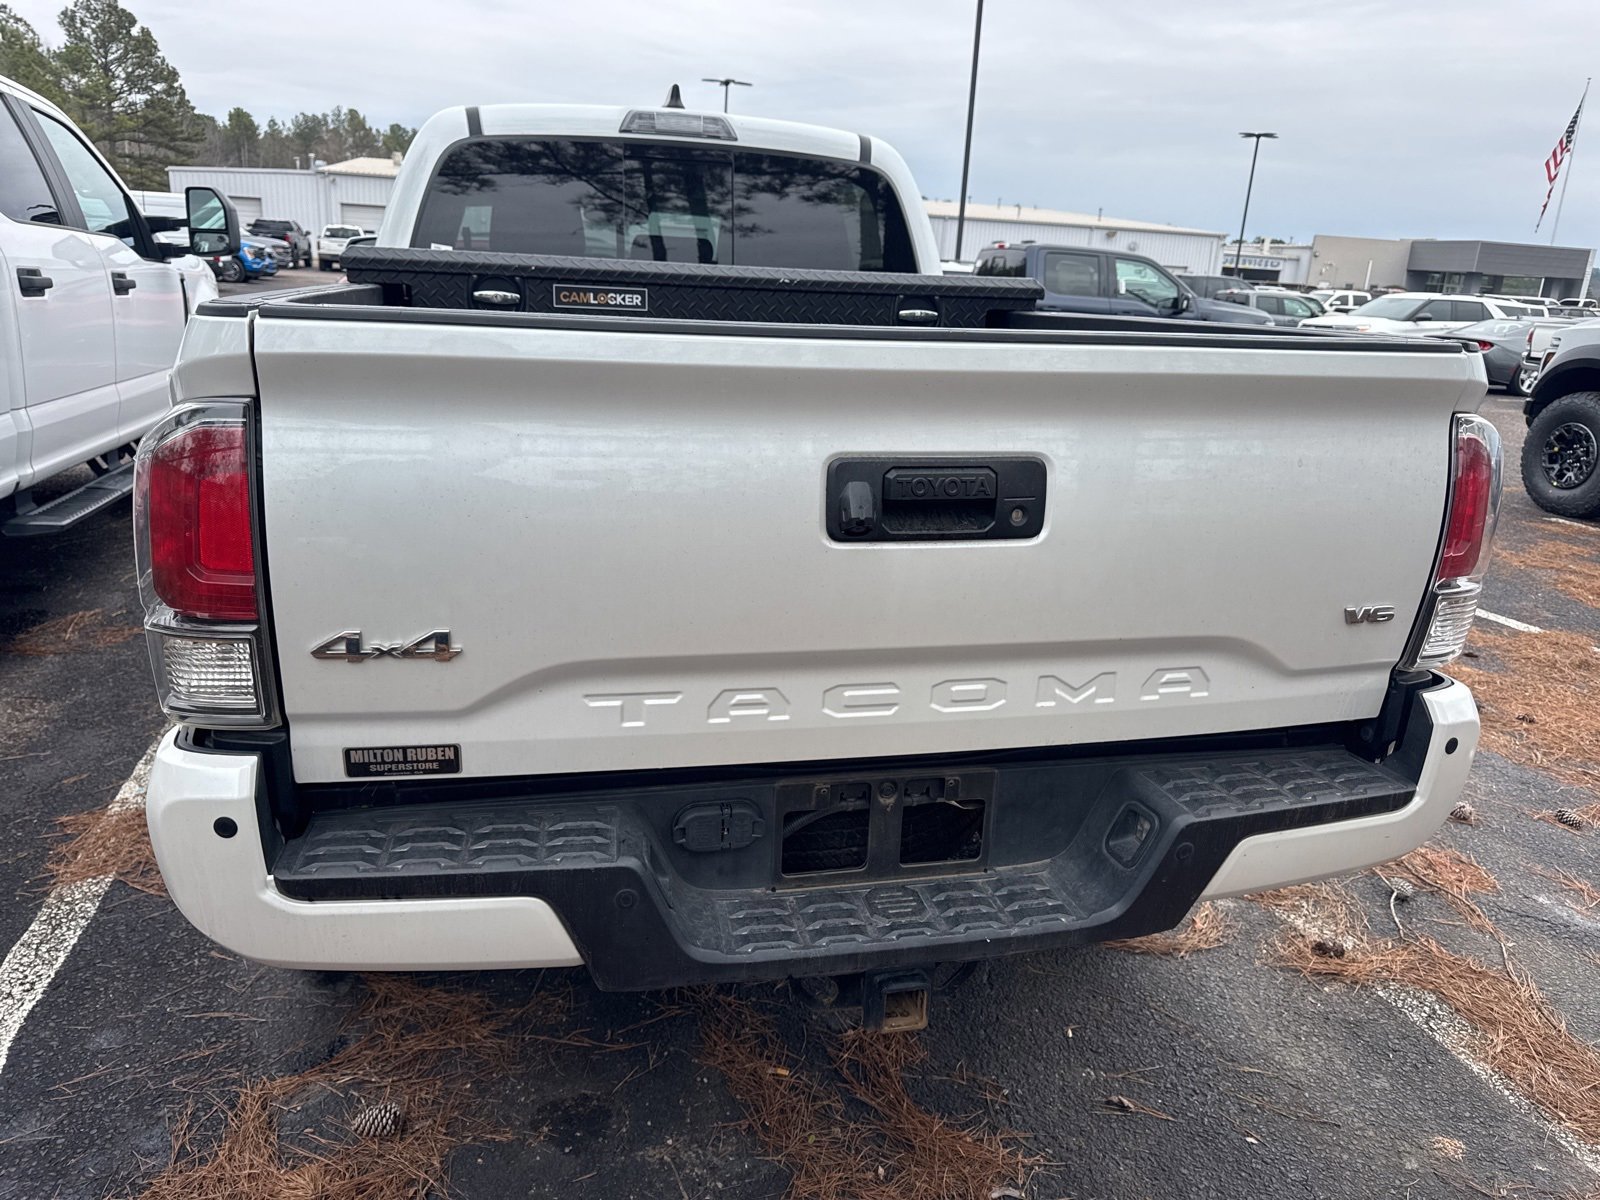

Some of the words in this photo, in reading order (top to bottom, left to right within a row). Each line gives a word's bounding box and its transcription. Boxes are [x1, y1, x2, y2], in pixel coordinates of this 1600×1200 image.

[560, 291, 642, 306] CAMLOCKER
[896, 476, 991, 497] TOYOTA
[1344, 605, 1395, 625] V6
[310, 629, 463, 663] 4x4
[584, 666, 1210, 727] TACOMA
[350, 749, 403, 763] MILTON
[407, 747, 455, 761] RUBEN
[369, 762, 439, 772] SUPERSTORE
